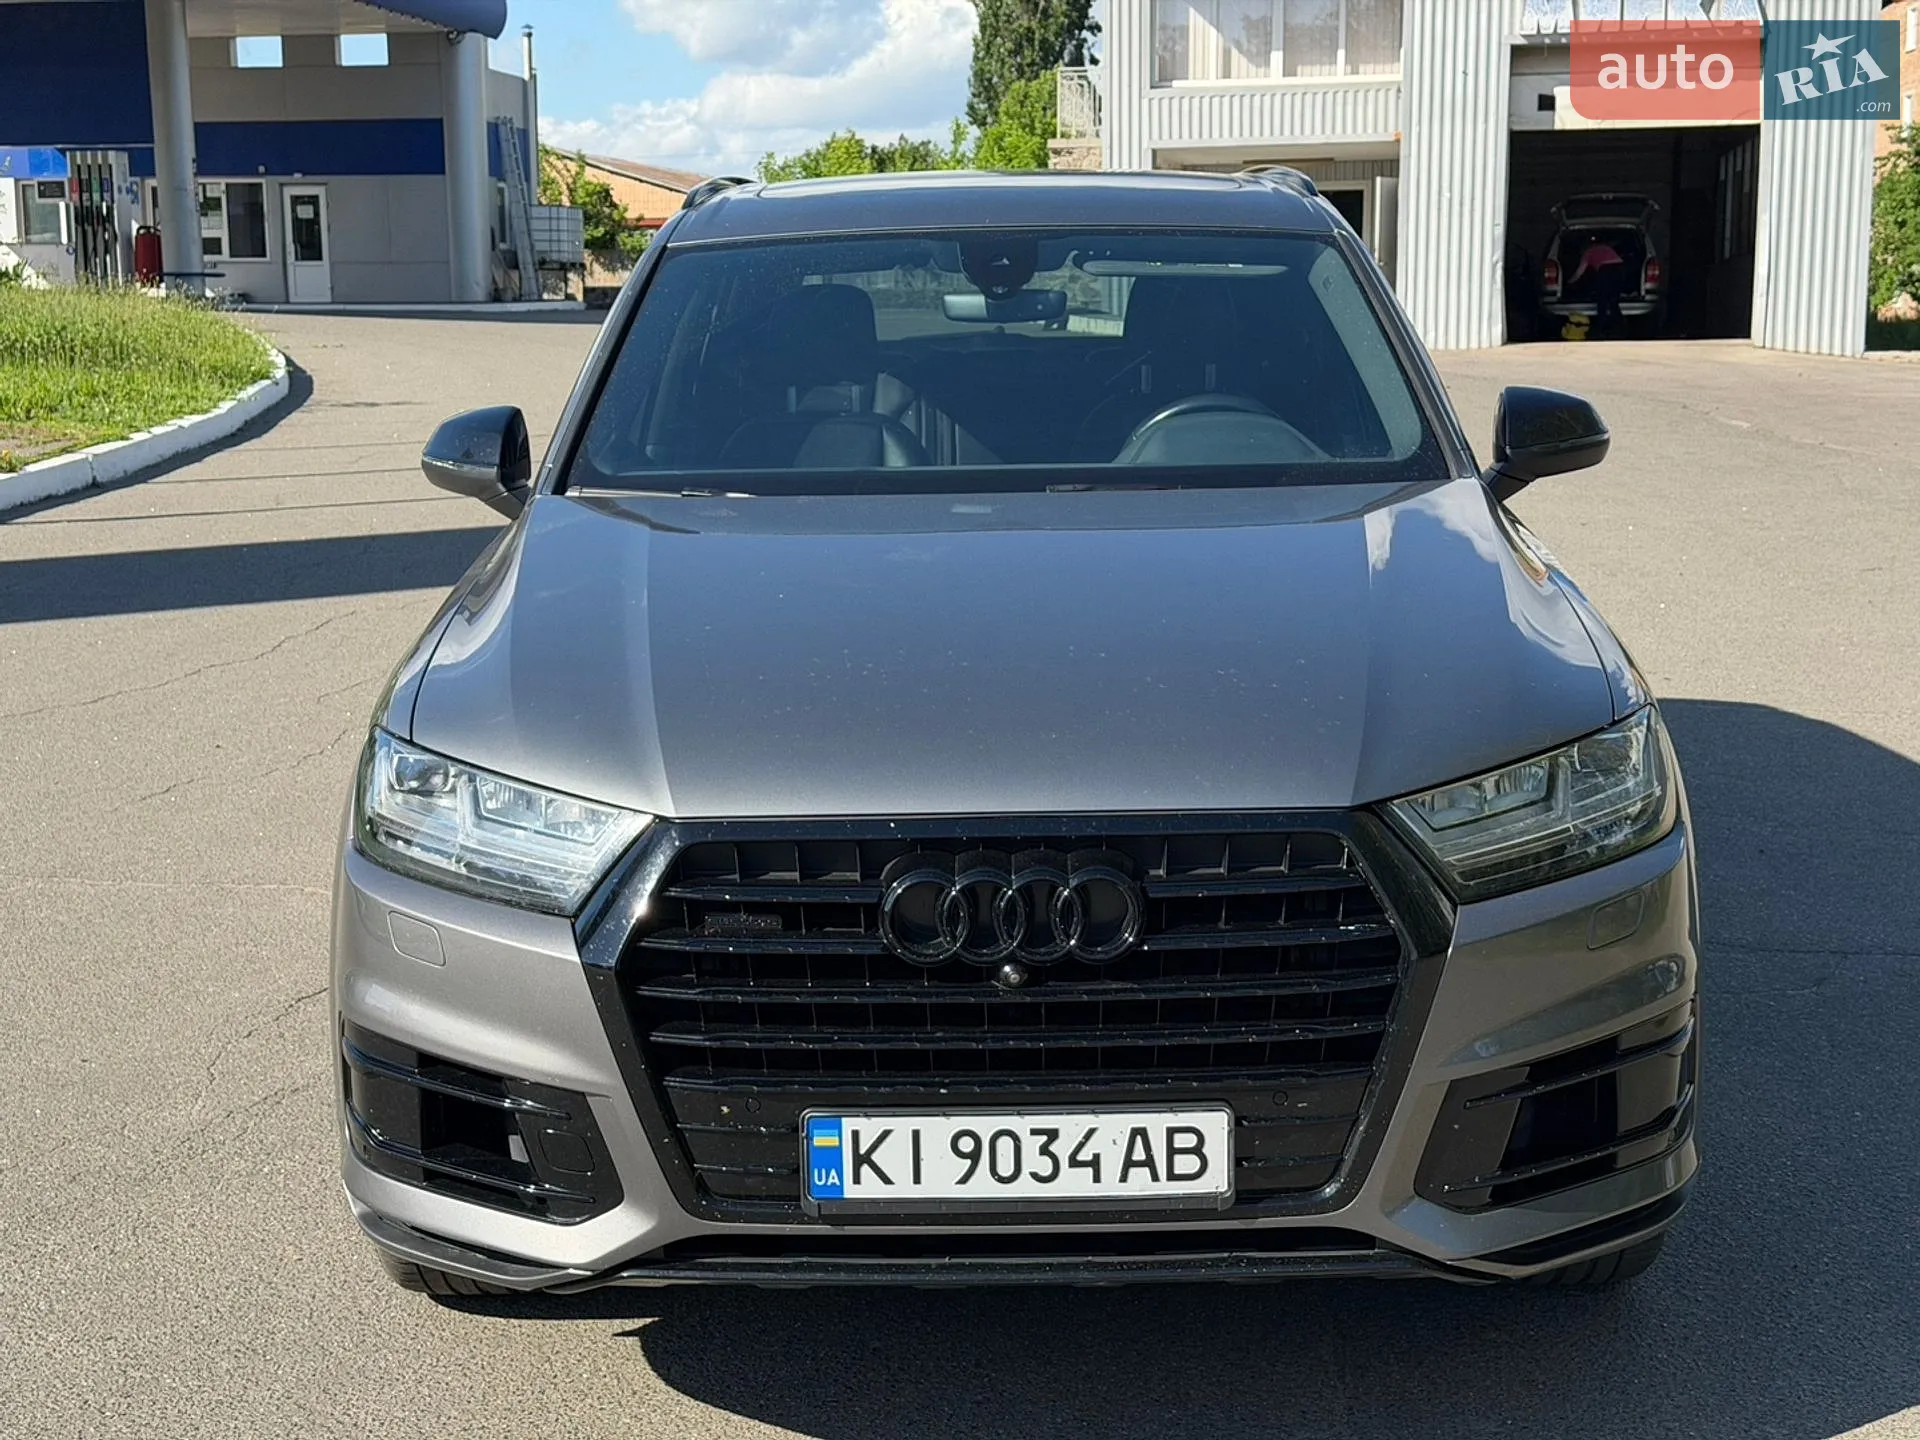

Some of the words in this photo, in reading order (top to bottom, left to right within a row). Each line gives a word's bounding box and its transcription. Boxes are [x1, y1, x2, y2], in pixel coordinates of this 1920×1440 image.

[851, 1128, 921, 1185] KI
[950, 1127, 1101, 1185] 9034
[1118, 1126, 1208, 1183] AB
[813, 1168, 840, 1186] UA
